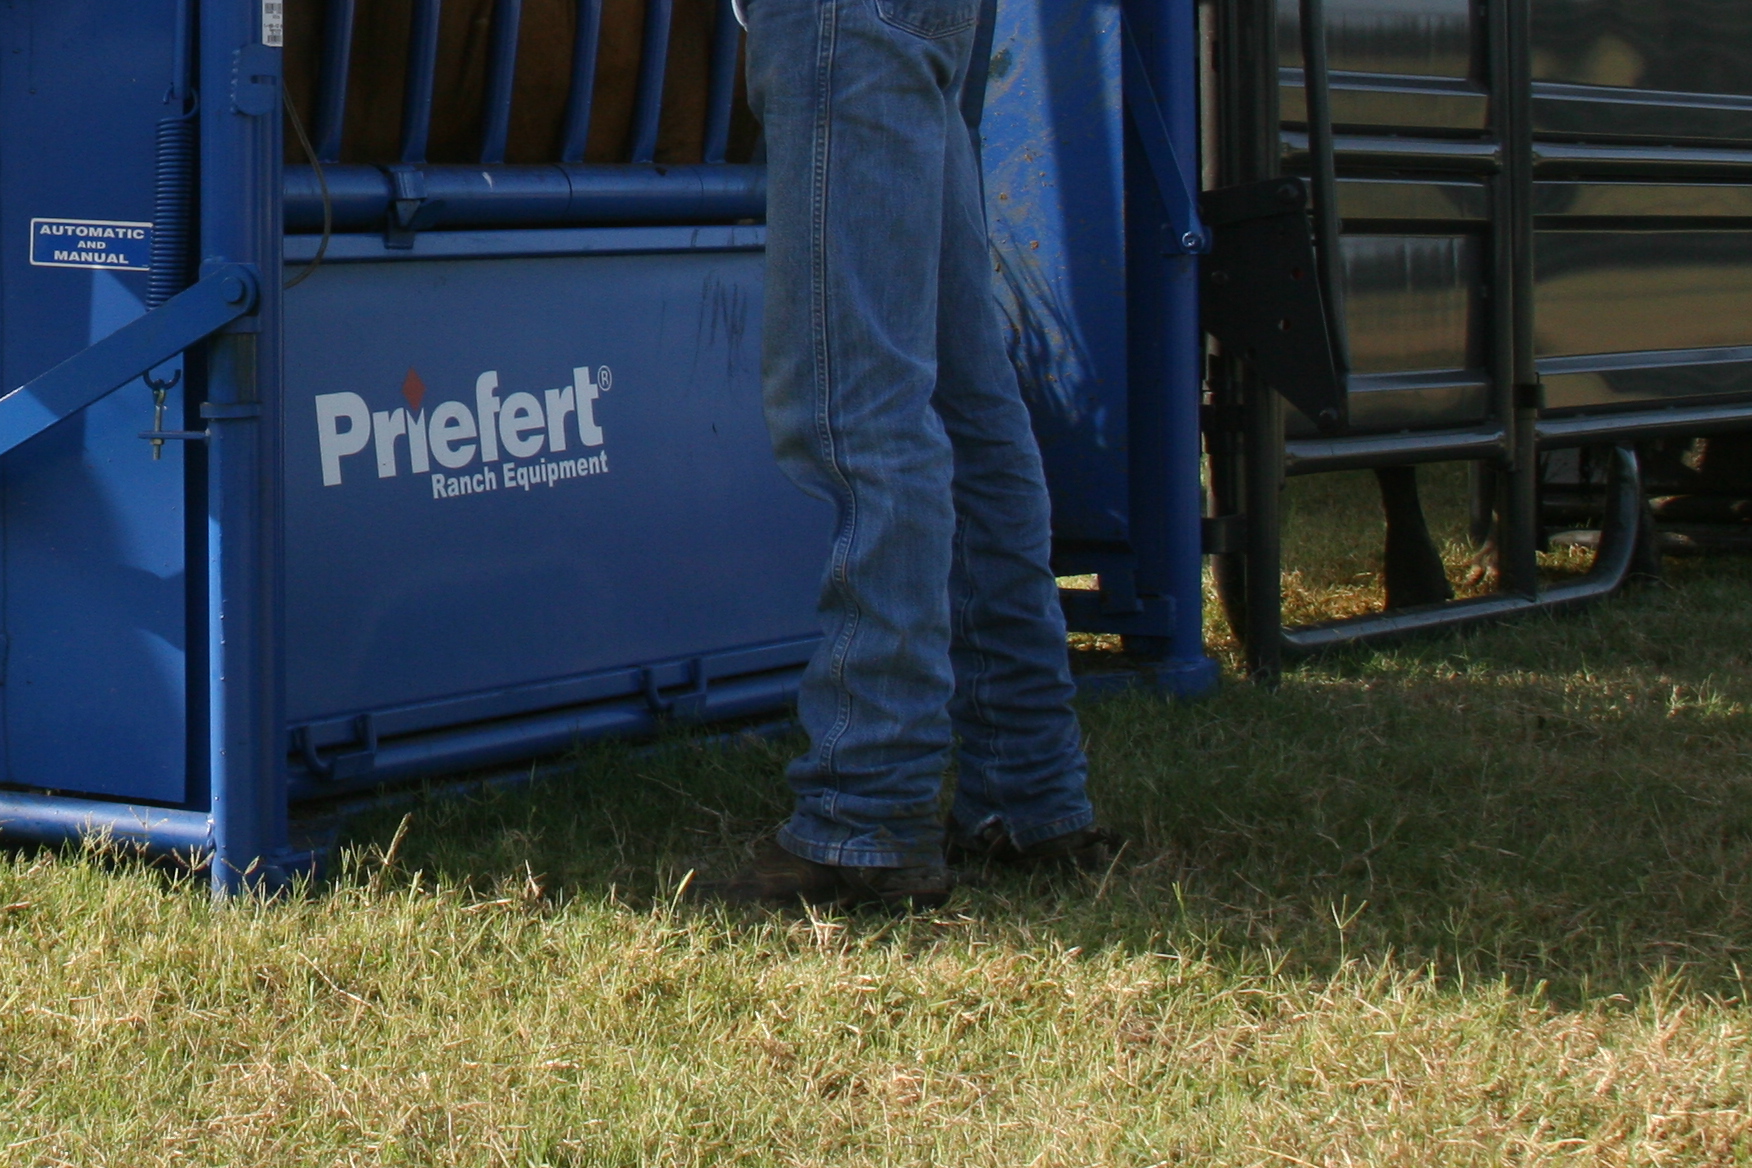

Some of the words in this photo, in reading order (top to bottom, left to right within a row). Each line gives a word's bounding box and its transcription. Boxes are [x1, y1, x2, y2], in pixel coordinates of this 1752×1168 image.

[40, 224, 145, 240] AUTOMATIC
[77, 240, 106, 249] AND
[54, 250, 129, 264] MANUAL
[431, 466, 497, 499] Ranch
[502, 449, 609, 491] Equipment
